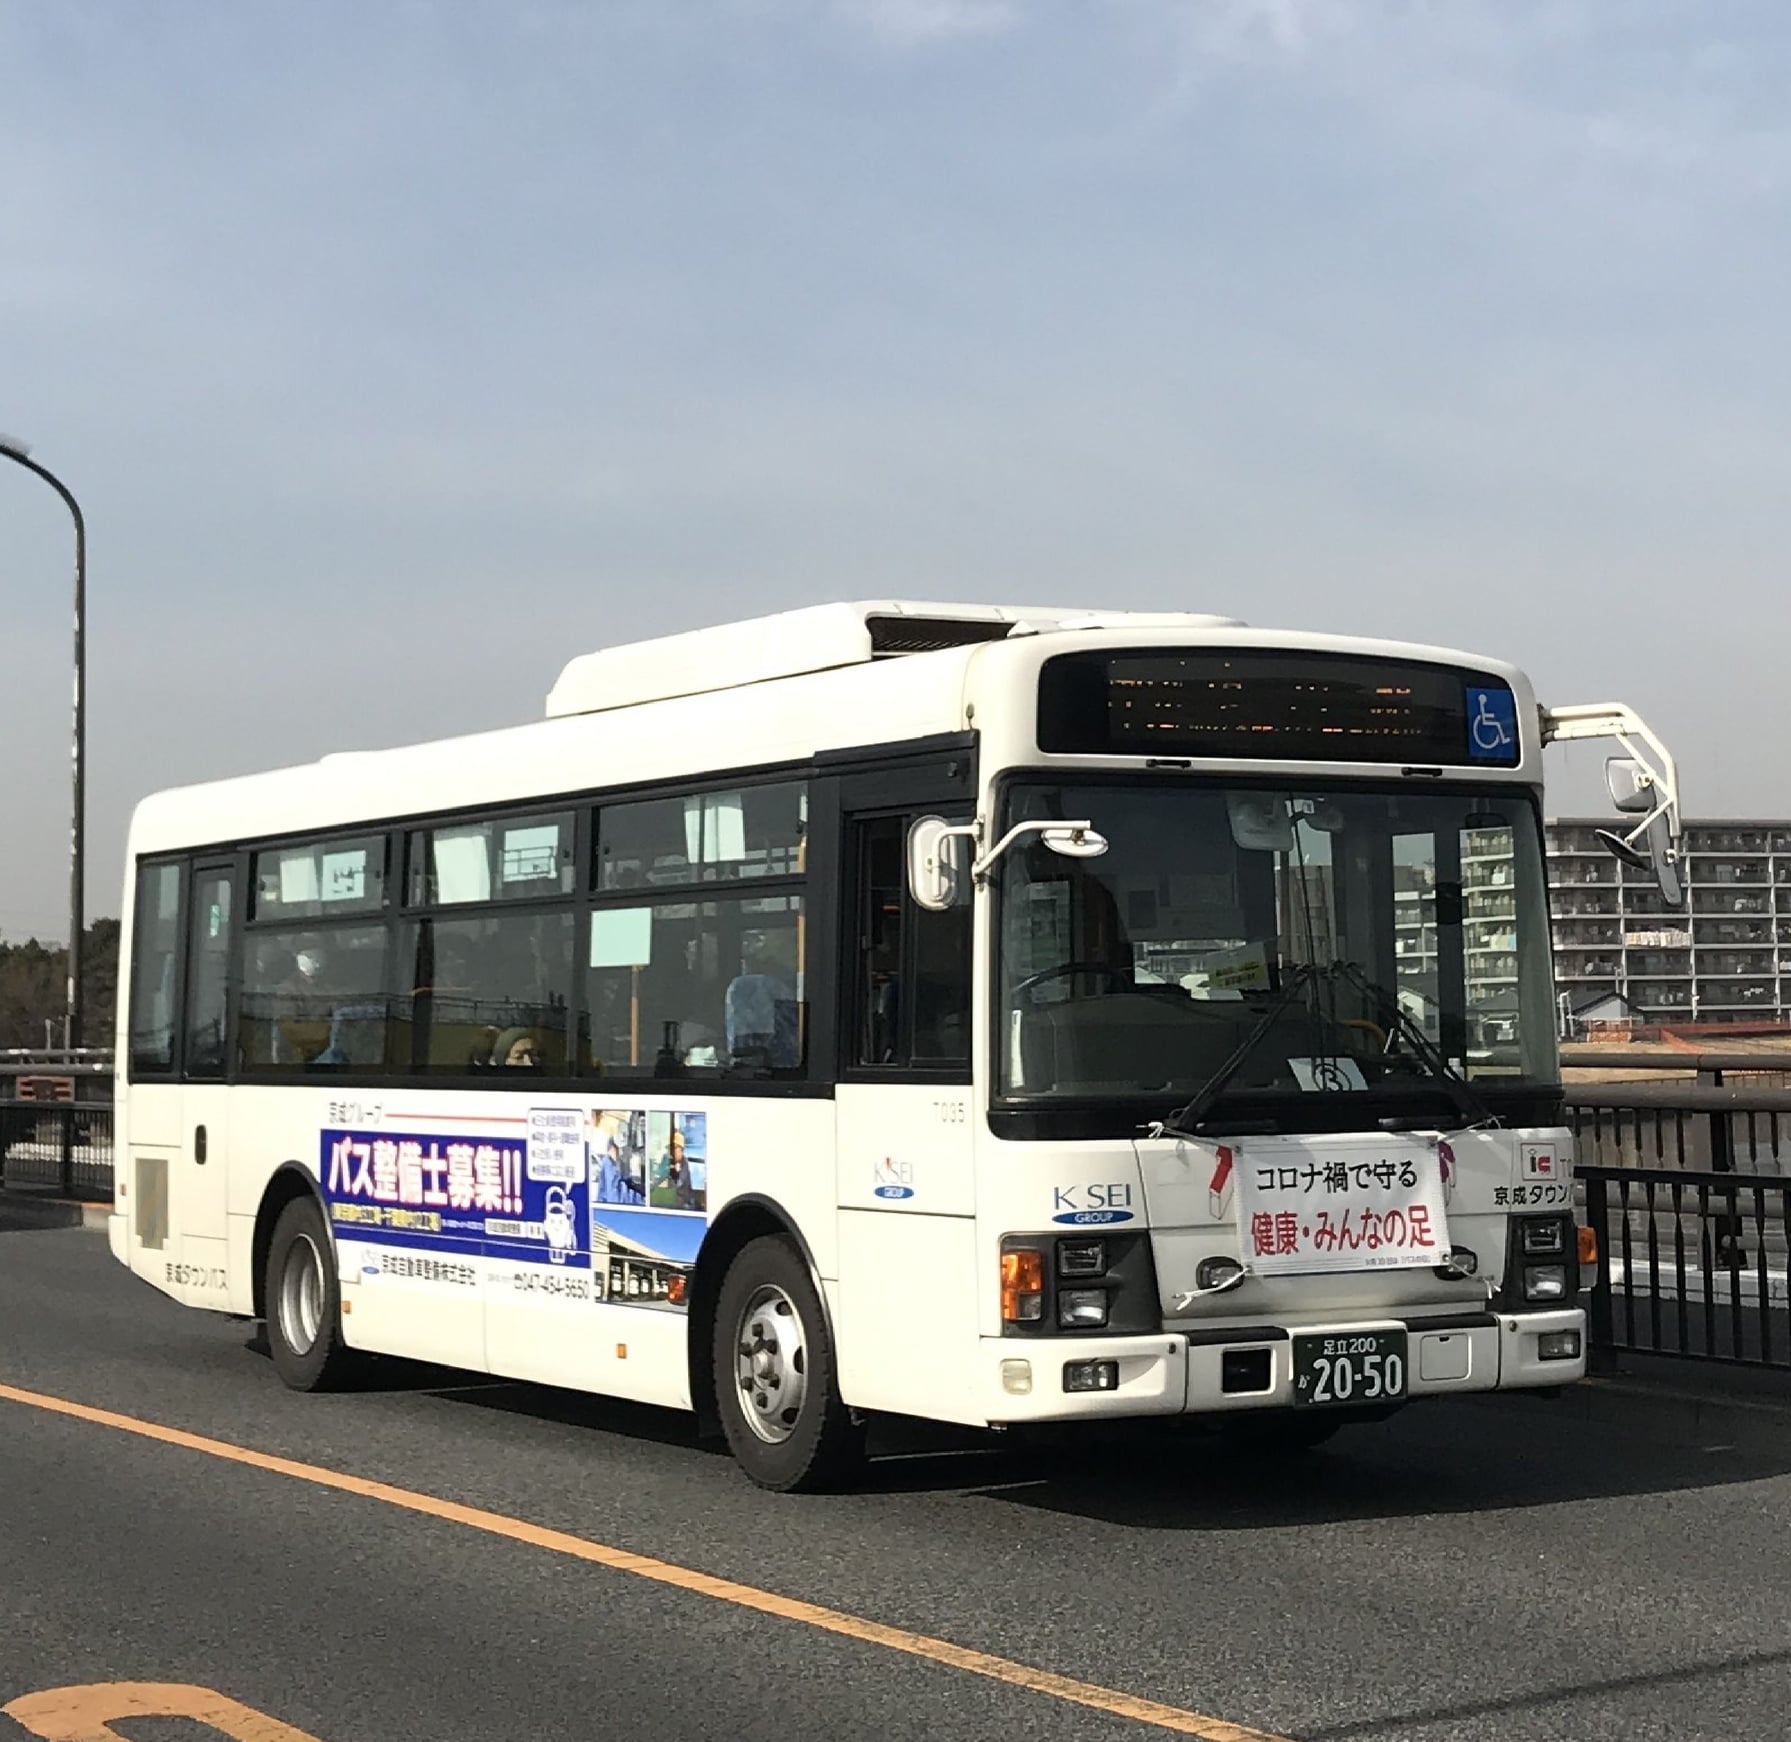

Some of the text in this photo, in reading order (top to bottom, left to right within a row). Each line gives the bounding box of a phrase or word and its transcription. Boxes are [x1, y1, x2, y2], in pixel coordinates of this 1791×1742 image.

[1256, 1159, 1418, 1194] コロナ禍で守る
[1074, 1211, 1114, 1223] GROUP
[1251, 1204, 1436, 1257] 健康・みんなの足
[1323, 1337, 1377, 1355] 足立200
[1313, 1354, 1403, 1402] 20-50
